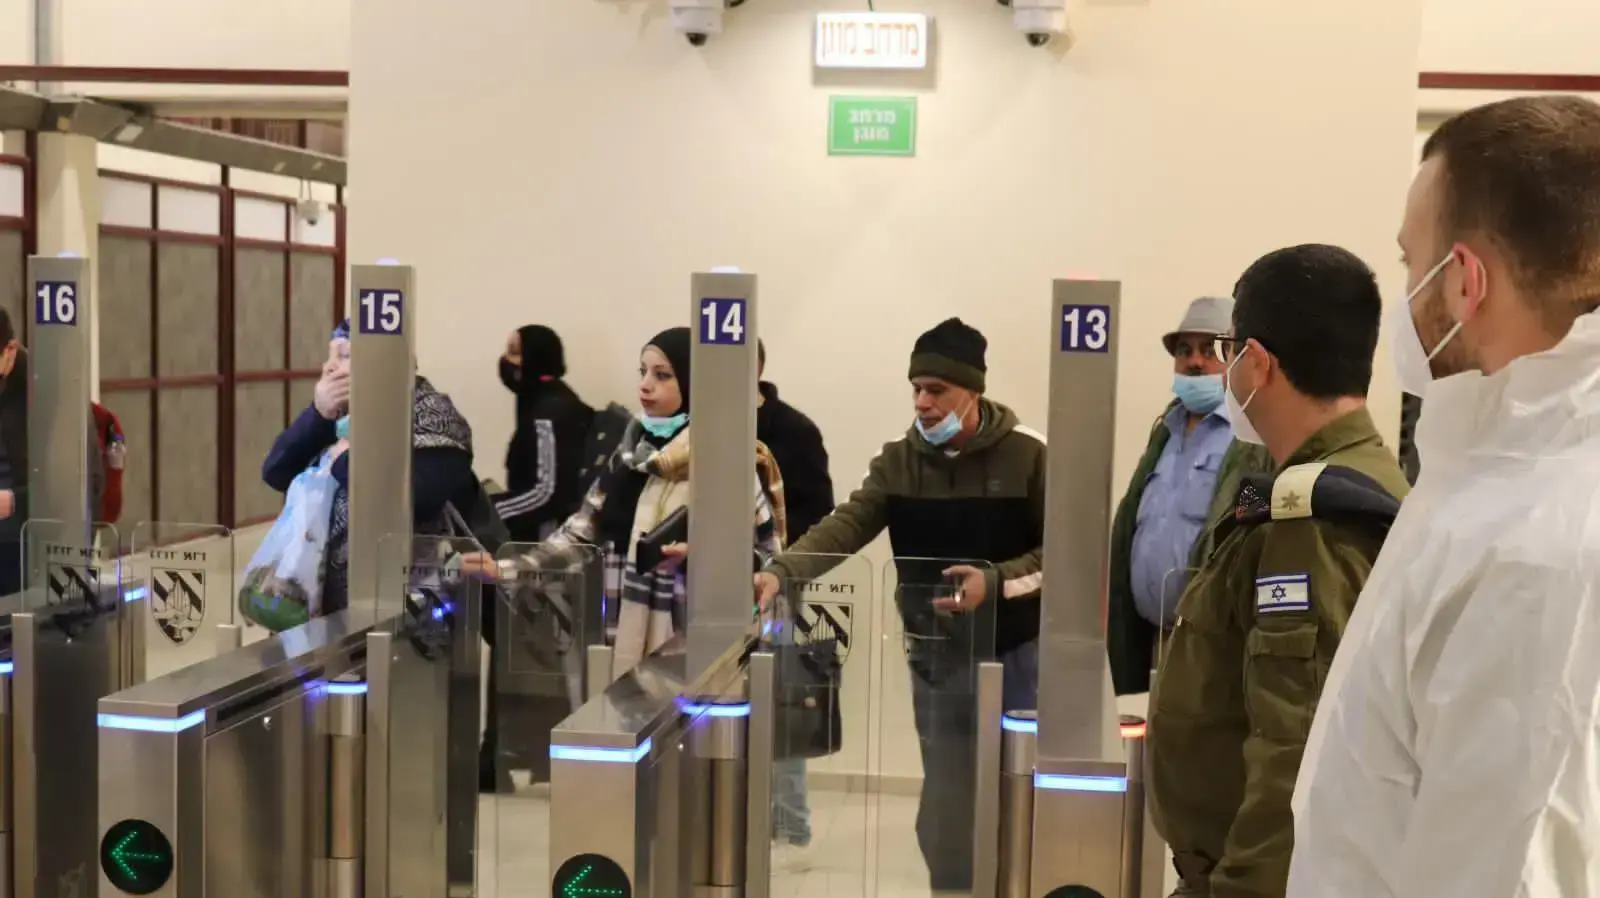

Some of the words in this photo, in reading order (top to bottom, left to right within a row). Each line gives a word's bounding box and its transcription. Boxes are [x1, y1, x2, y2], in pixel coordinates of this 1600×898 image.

[863, 22, 919, 56] מרחב
[848, 108, 897, 125] מרחב
[36, 285, 76, 323] 16
[360, 291, 401, 332] 15
[702, 301, 744, 342] 14
[1063, 308, 1108, 350] 13
